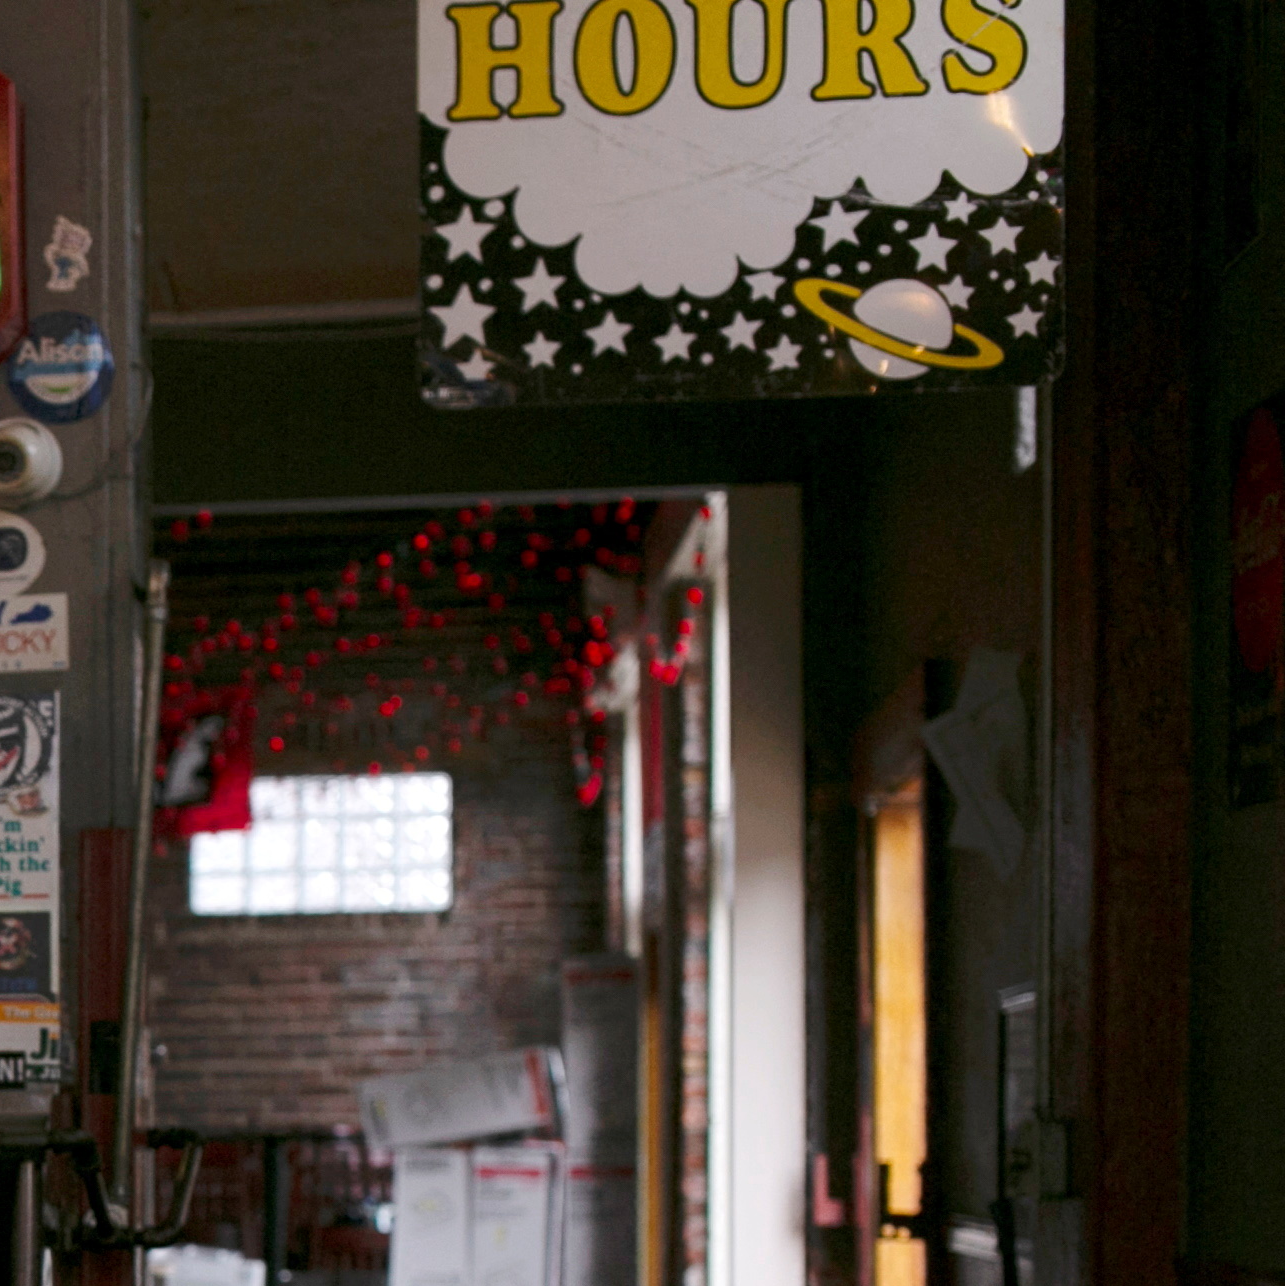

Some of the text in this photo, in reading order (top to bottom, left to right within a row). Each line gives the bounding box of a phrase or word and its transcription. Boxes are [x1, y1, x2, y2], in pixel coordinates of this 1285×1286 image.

[446, 0, 1029, 121] HOURS
[18, 338, 103, 367] Alison
[18, 853, 51, 873] the
